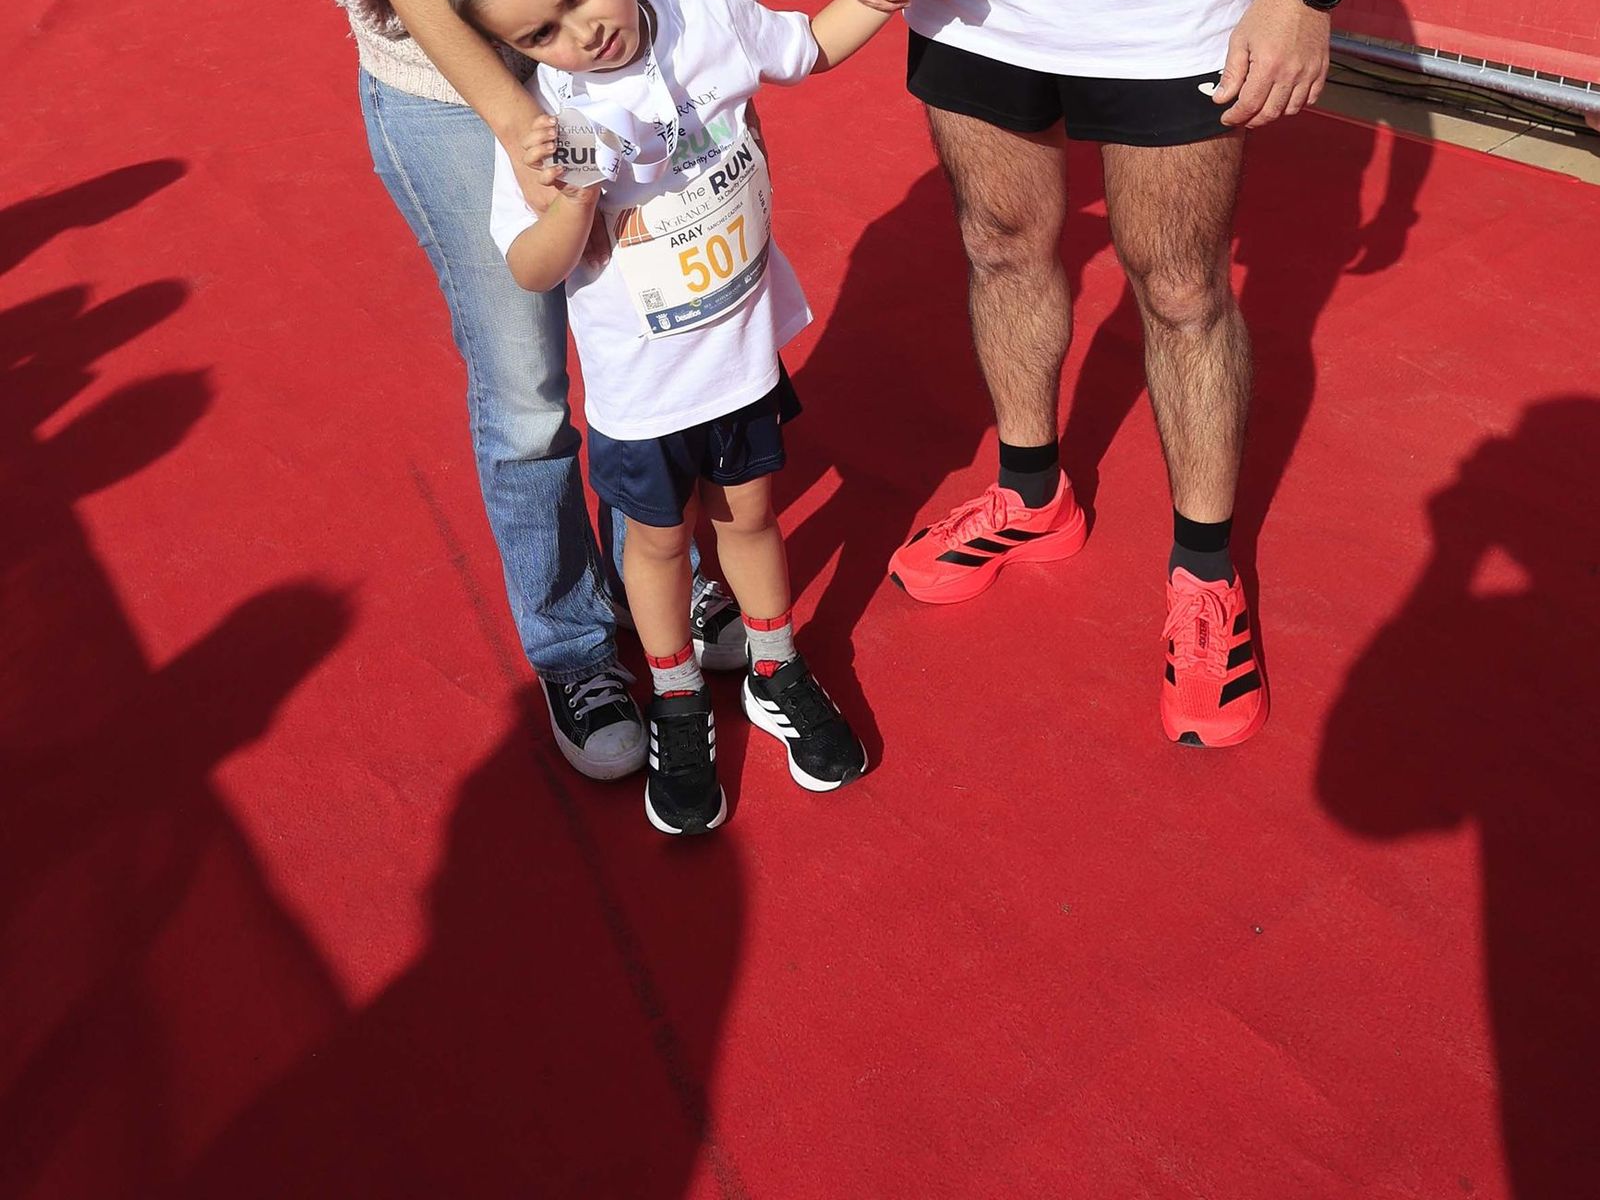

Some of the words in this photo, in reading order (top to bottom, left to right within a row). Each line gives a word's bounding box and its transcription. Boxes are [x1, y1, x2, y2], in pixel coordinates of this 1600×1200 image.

[557, 138, 571, 147] he
[657, 127, 686, 142] Te
[682, 152, 708, 171] Charity
[679, 187, 706, 205] The
[709, 143, 753, 195] RUN
[724, 179, 741, 198] Charity
[670, 224, 704, 248] ARAY
[678, 214, 748, 293] 507
